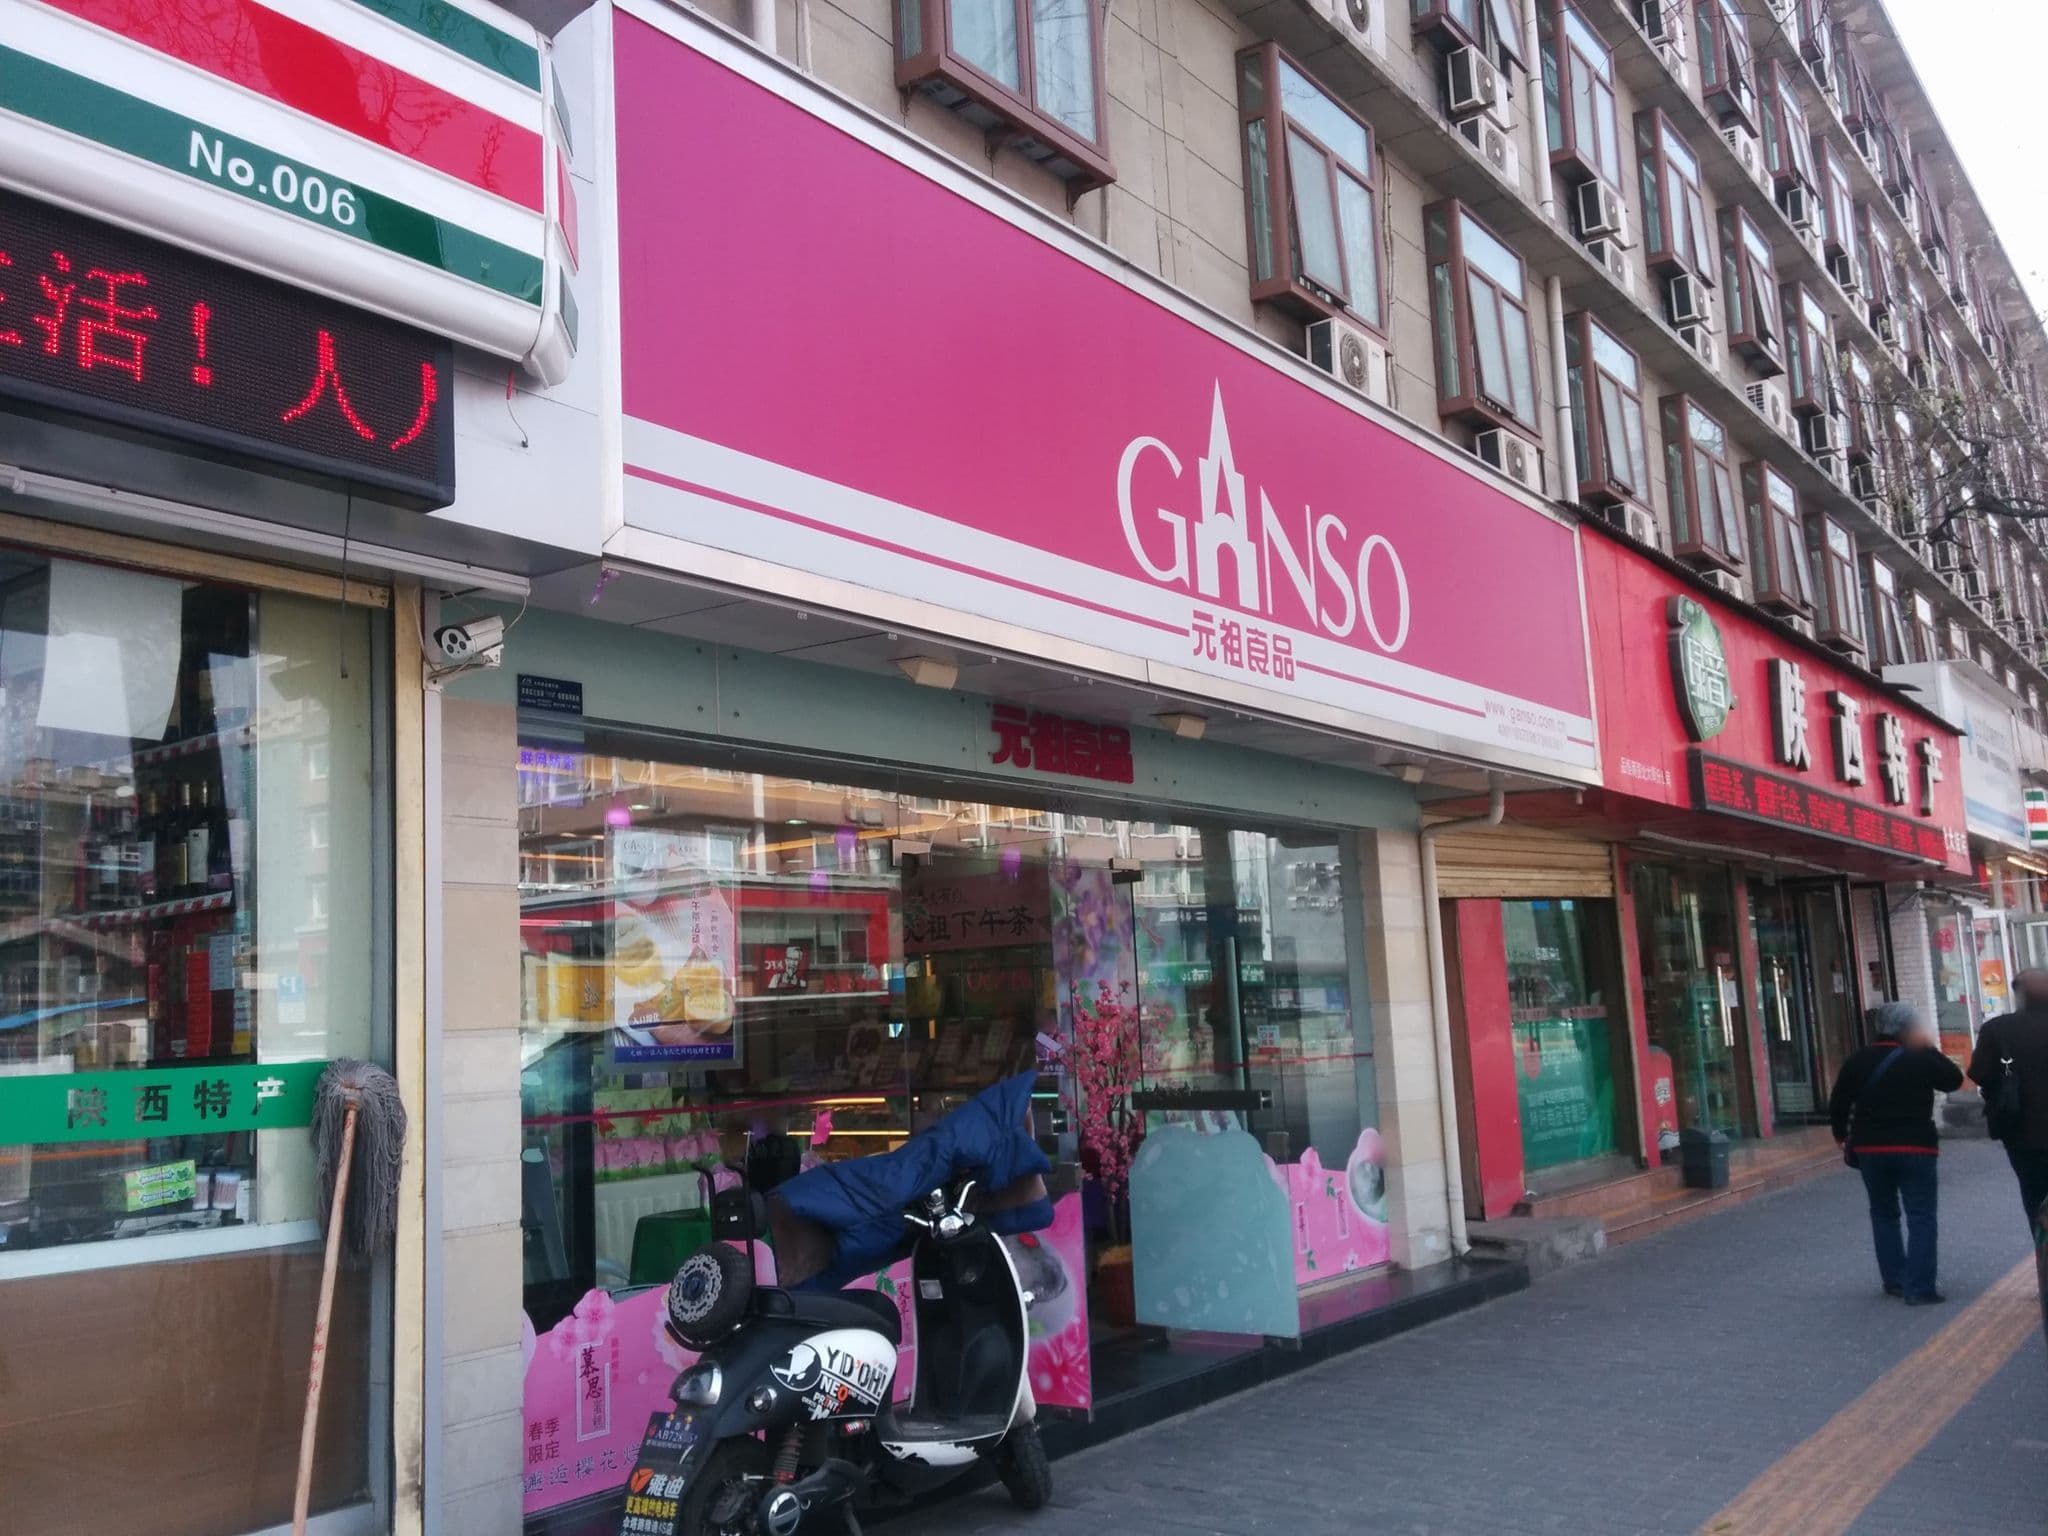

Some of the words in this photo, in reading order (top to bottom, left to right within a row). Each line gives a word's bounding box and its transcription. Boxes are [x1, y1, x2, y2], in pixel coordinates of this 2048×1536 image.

[188, 130, 357, 227] No.006
[1117, 378, 1411, 653] GANSO
[1191, 611, 1296, 682] 元祖食品
[991, 703, 1135, 785] 元祖食品
[1774, 658, 1943, 816] 陕西特产
[67, 1076, 289, 1130] 陕西特产
[820, 1374, 849, 1402] NEO
[528, 1417, 561, 1442] 春季
[528, 1440, 561, 1465] 限定
[646, 1474, 686, 1499] 雅迪
